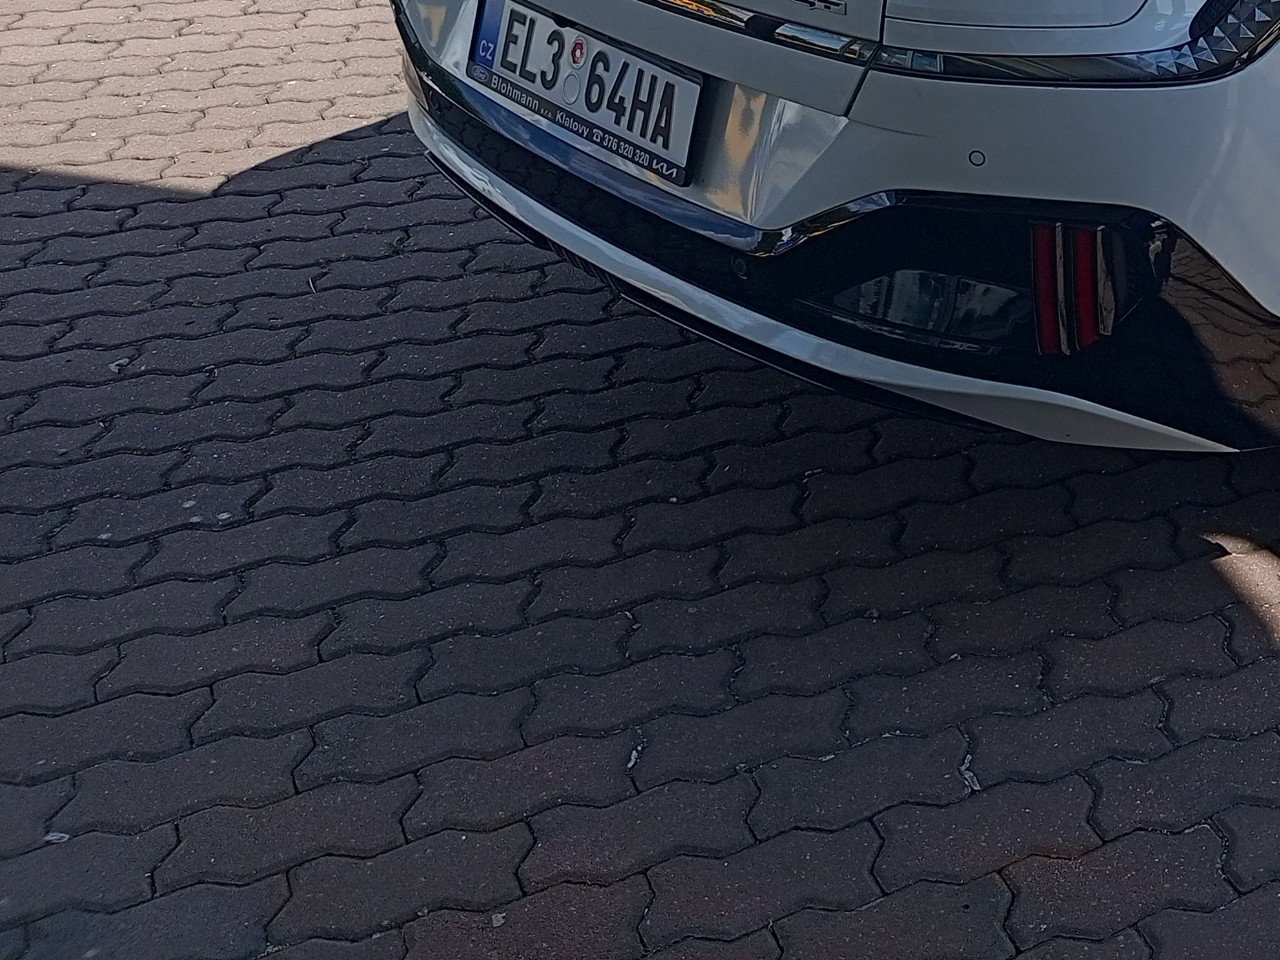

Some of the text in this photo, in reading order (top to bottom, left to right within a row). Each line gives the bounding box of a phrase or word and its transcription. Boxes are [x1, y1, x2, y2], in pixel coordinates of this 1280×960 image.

[478, 39, 495, 61] CZ
[500, 7, 678, 151] EL3 64HA
[491, 74, 539, 111] Blohmann
[555, 110, 590, 138] Klatovy
[603, 133, 618, 151] 376
[619, 141, 634, 159] 320
[634, 149, 650, 167] 320
[652, 159, 678, 178] KIA
